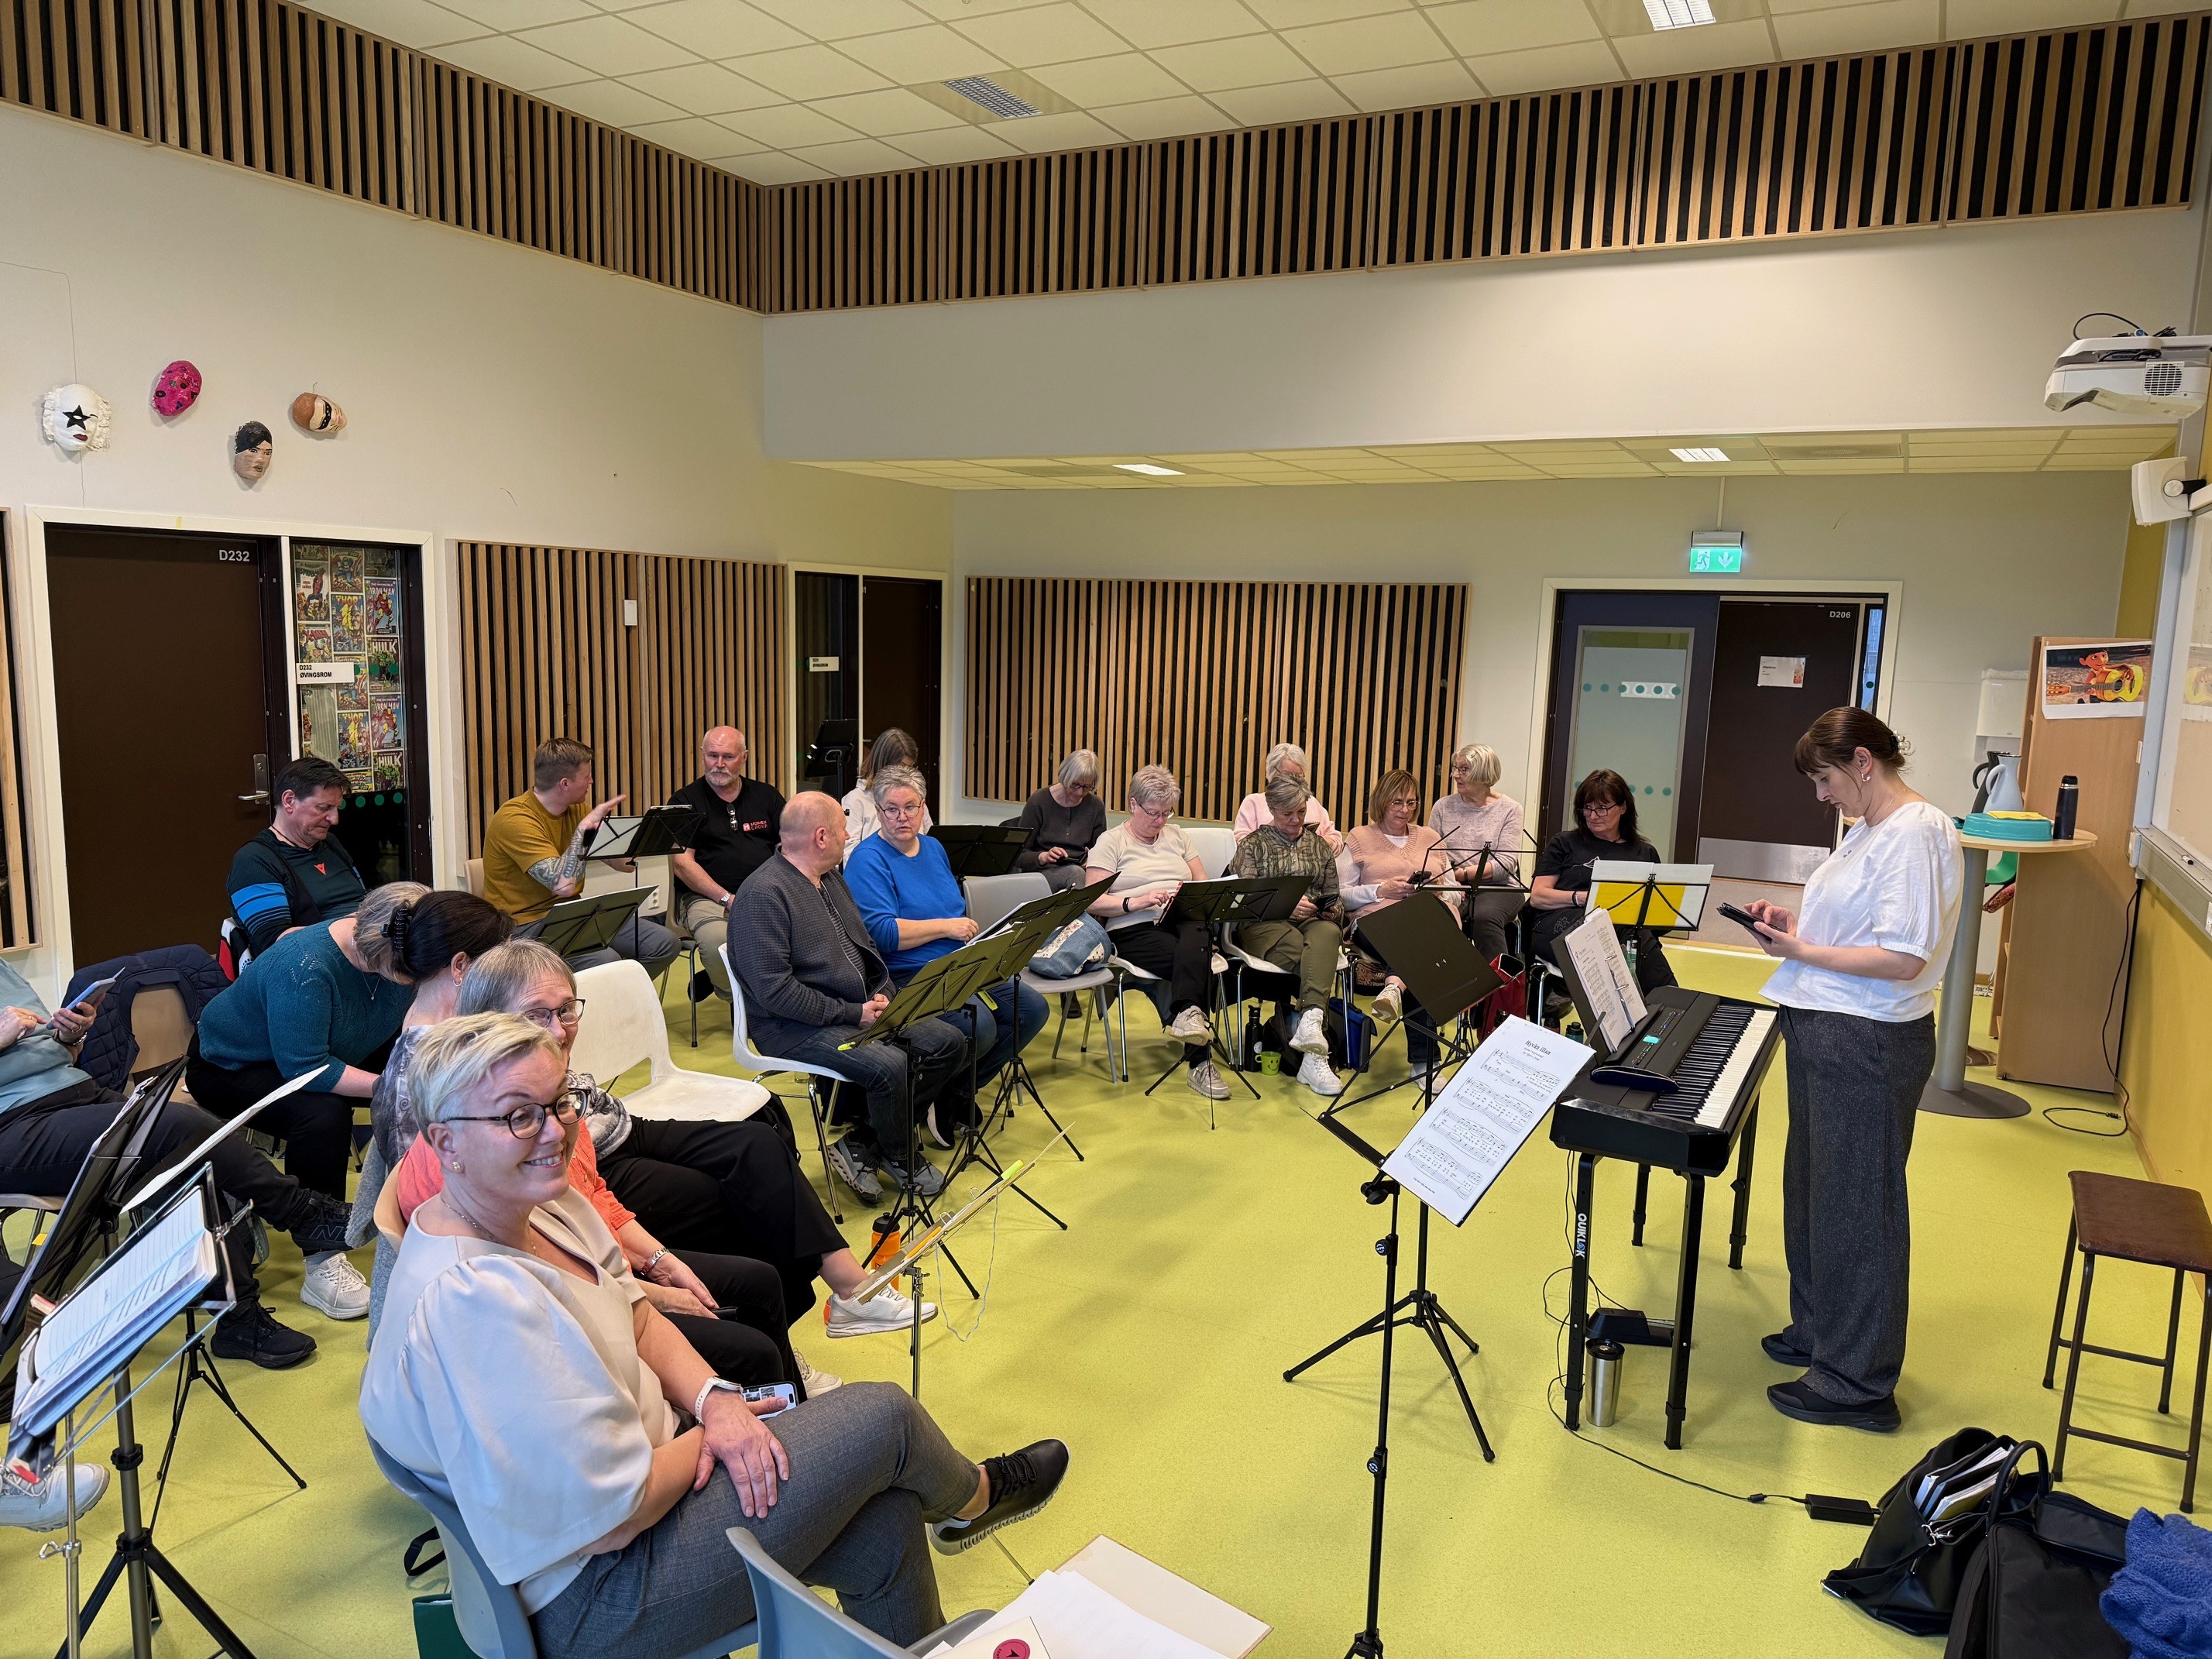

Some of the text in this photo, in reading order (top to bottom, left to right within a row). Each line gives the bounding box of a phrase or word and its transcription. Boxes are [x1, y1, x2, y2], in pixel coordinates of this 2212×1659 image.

[218, 549, 250, 562] D232
[335, 595, 359, 606] THOR
[1829, 610, 1851, 619] D206
[372, 640, 397, 654] HULK
[378, 751, 403, 768] HULK
